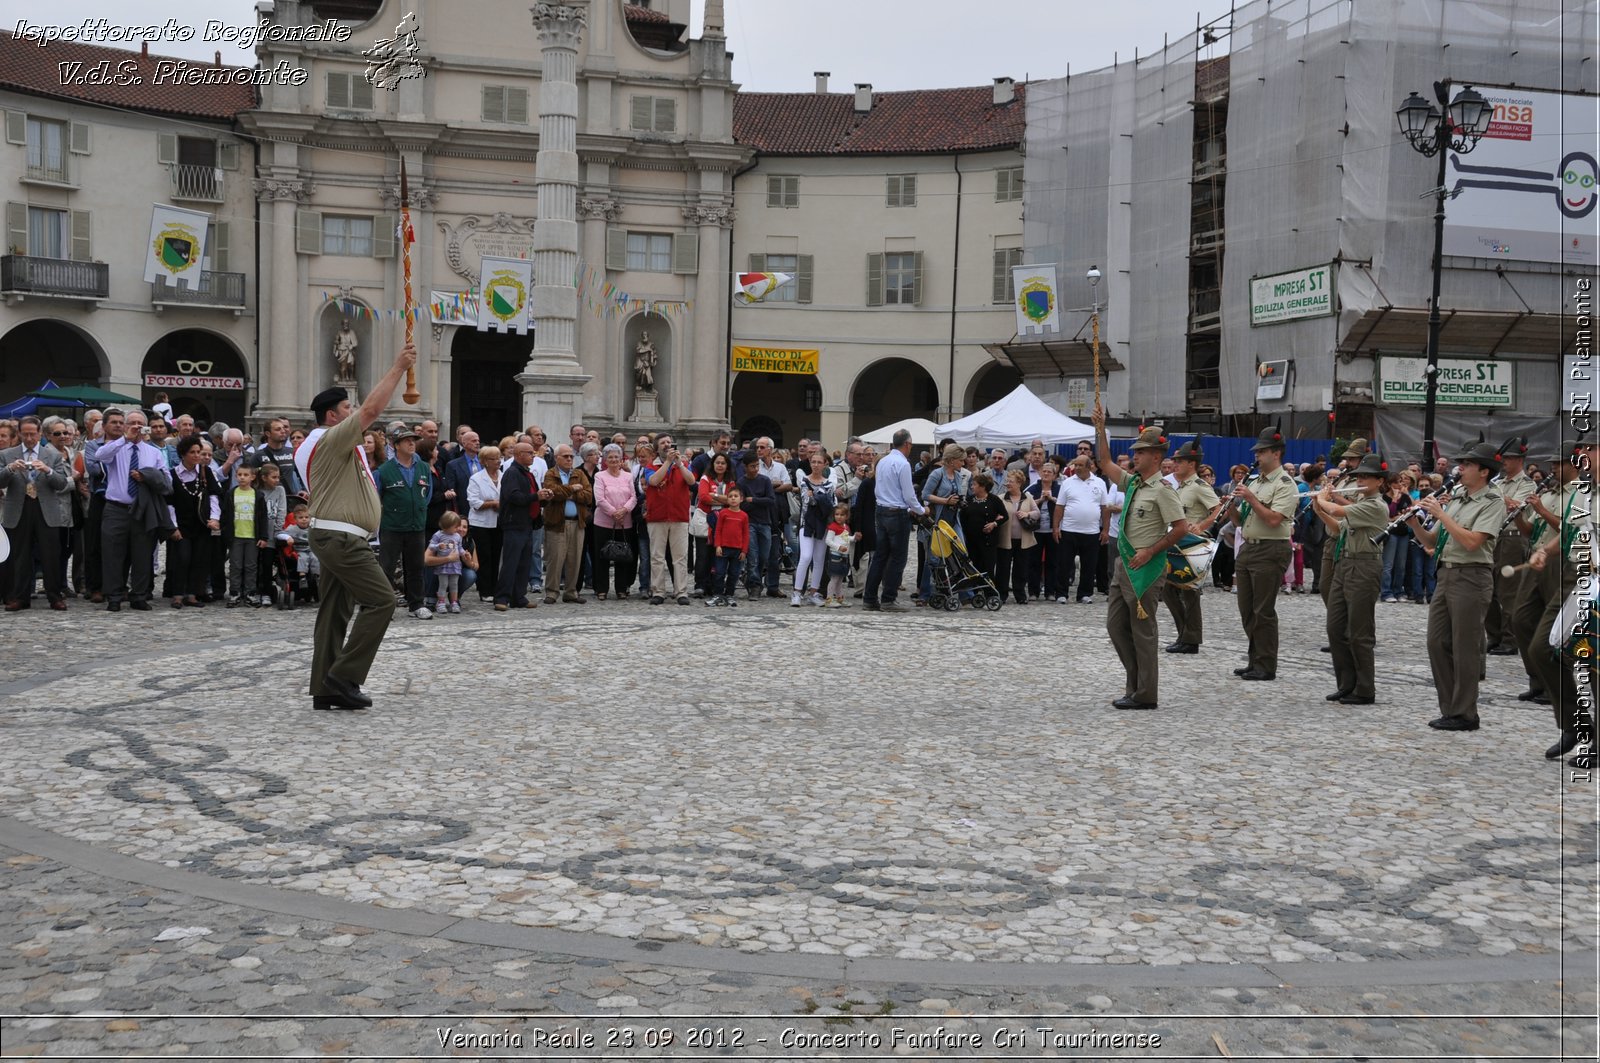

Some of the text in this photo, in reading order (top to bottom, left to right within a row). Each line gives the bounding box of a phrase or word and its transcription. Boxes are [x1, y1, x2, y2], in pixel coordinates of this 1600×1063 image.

[1493, 104, 1533, 122] nsa
[1274, 271, 1324, 297] IMPRESA ST
[1254, 303, 1285, 314] EDILIZIA
[1287, 294, 1328, 309] GENERALE
[750, 349, 802, 359] BANCO DI
[735, 358, 815, 372] BENEFICENZA
[1435, 363, 1498, 381] PRESA ST
[147, 376, 242, 388] FOTO OTTICA
[1439, 383, 1509, 395] GENERALE
